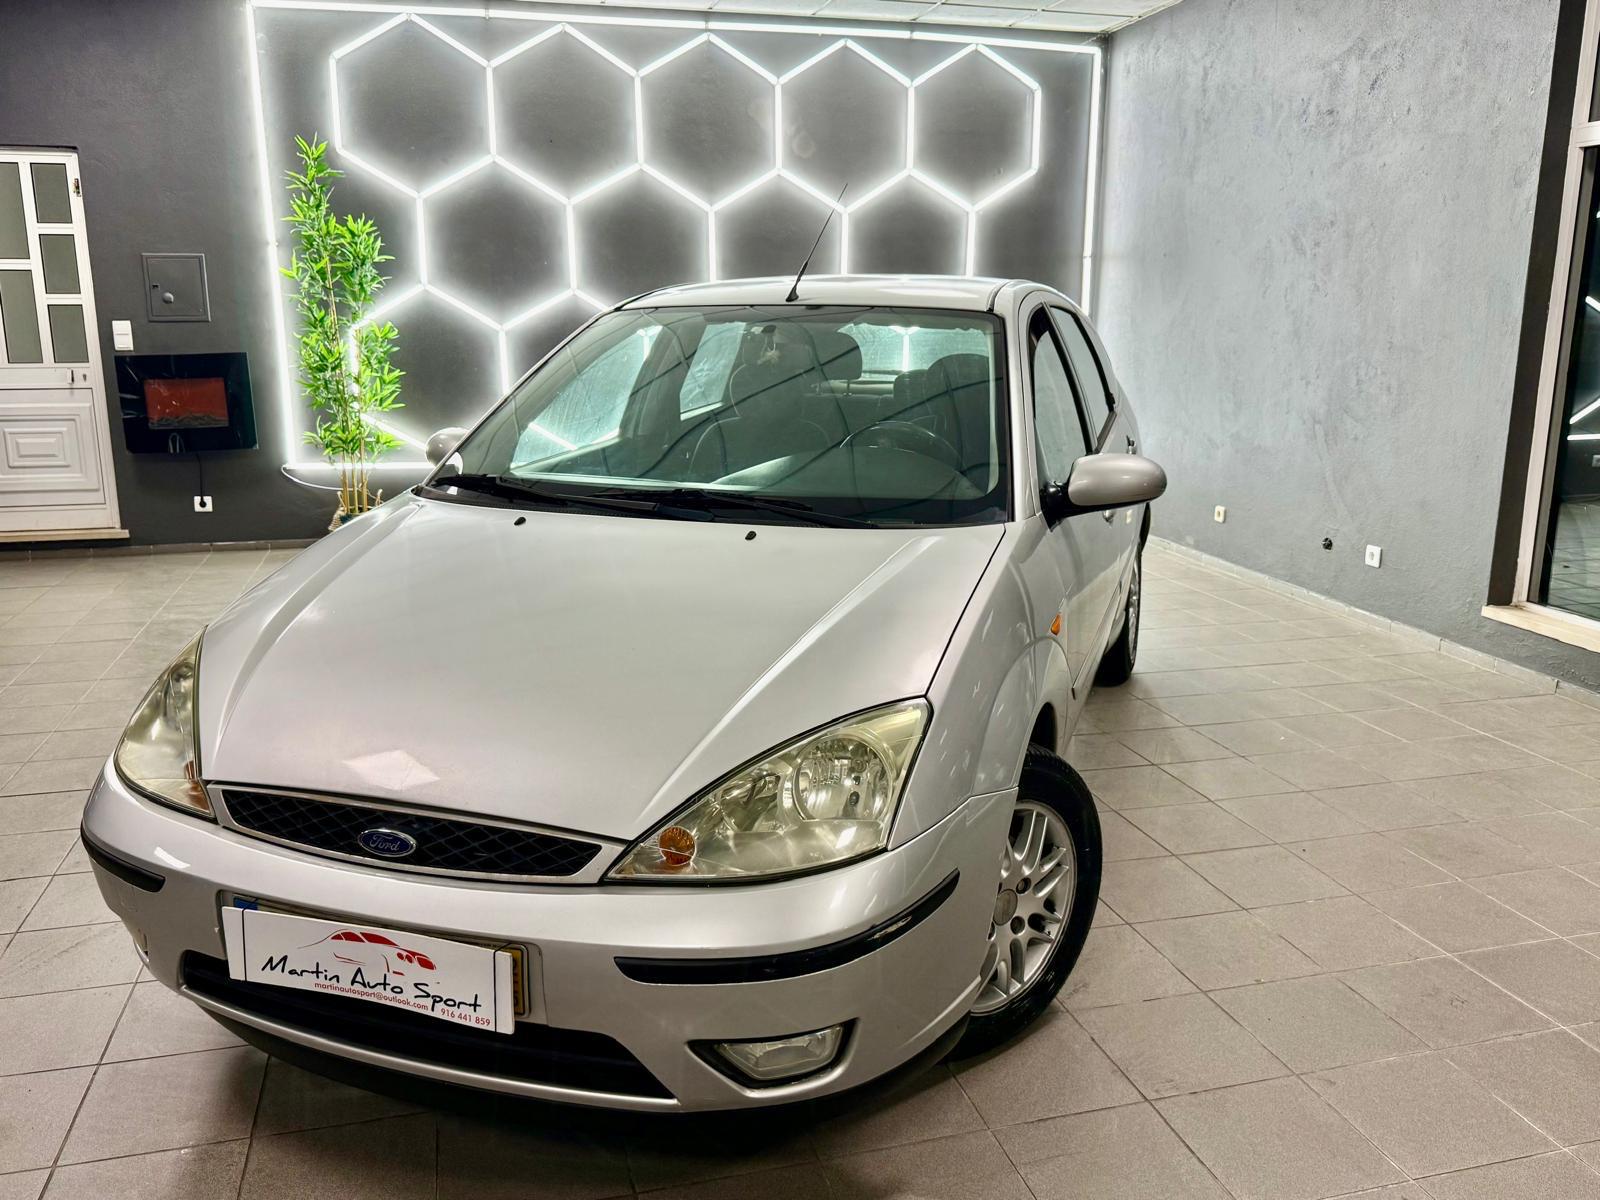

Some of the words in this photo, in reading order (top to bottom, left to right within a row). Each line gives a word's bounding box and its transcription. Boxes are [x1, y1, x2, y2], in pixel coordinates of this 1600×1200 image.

[369, 833, 401, 851] Ford
[261, 954, 340, 983] Martin
[350, 966, 404, 994] Auto
[413, 982, 482, 1012] Sport
[314, 981, 429, 1011] martinautosport@outlook.com
[440, 1007, 456, 1019] 916
[457, 1012, 472, 1022] 441
[474, 1016, 491, 1026] 859
